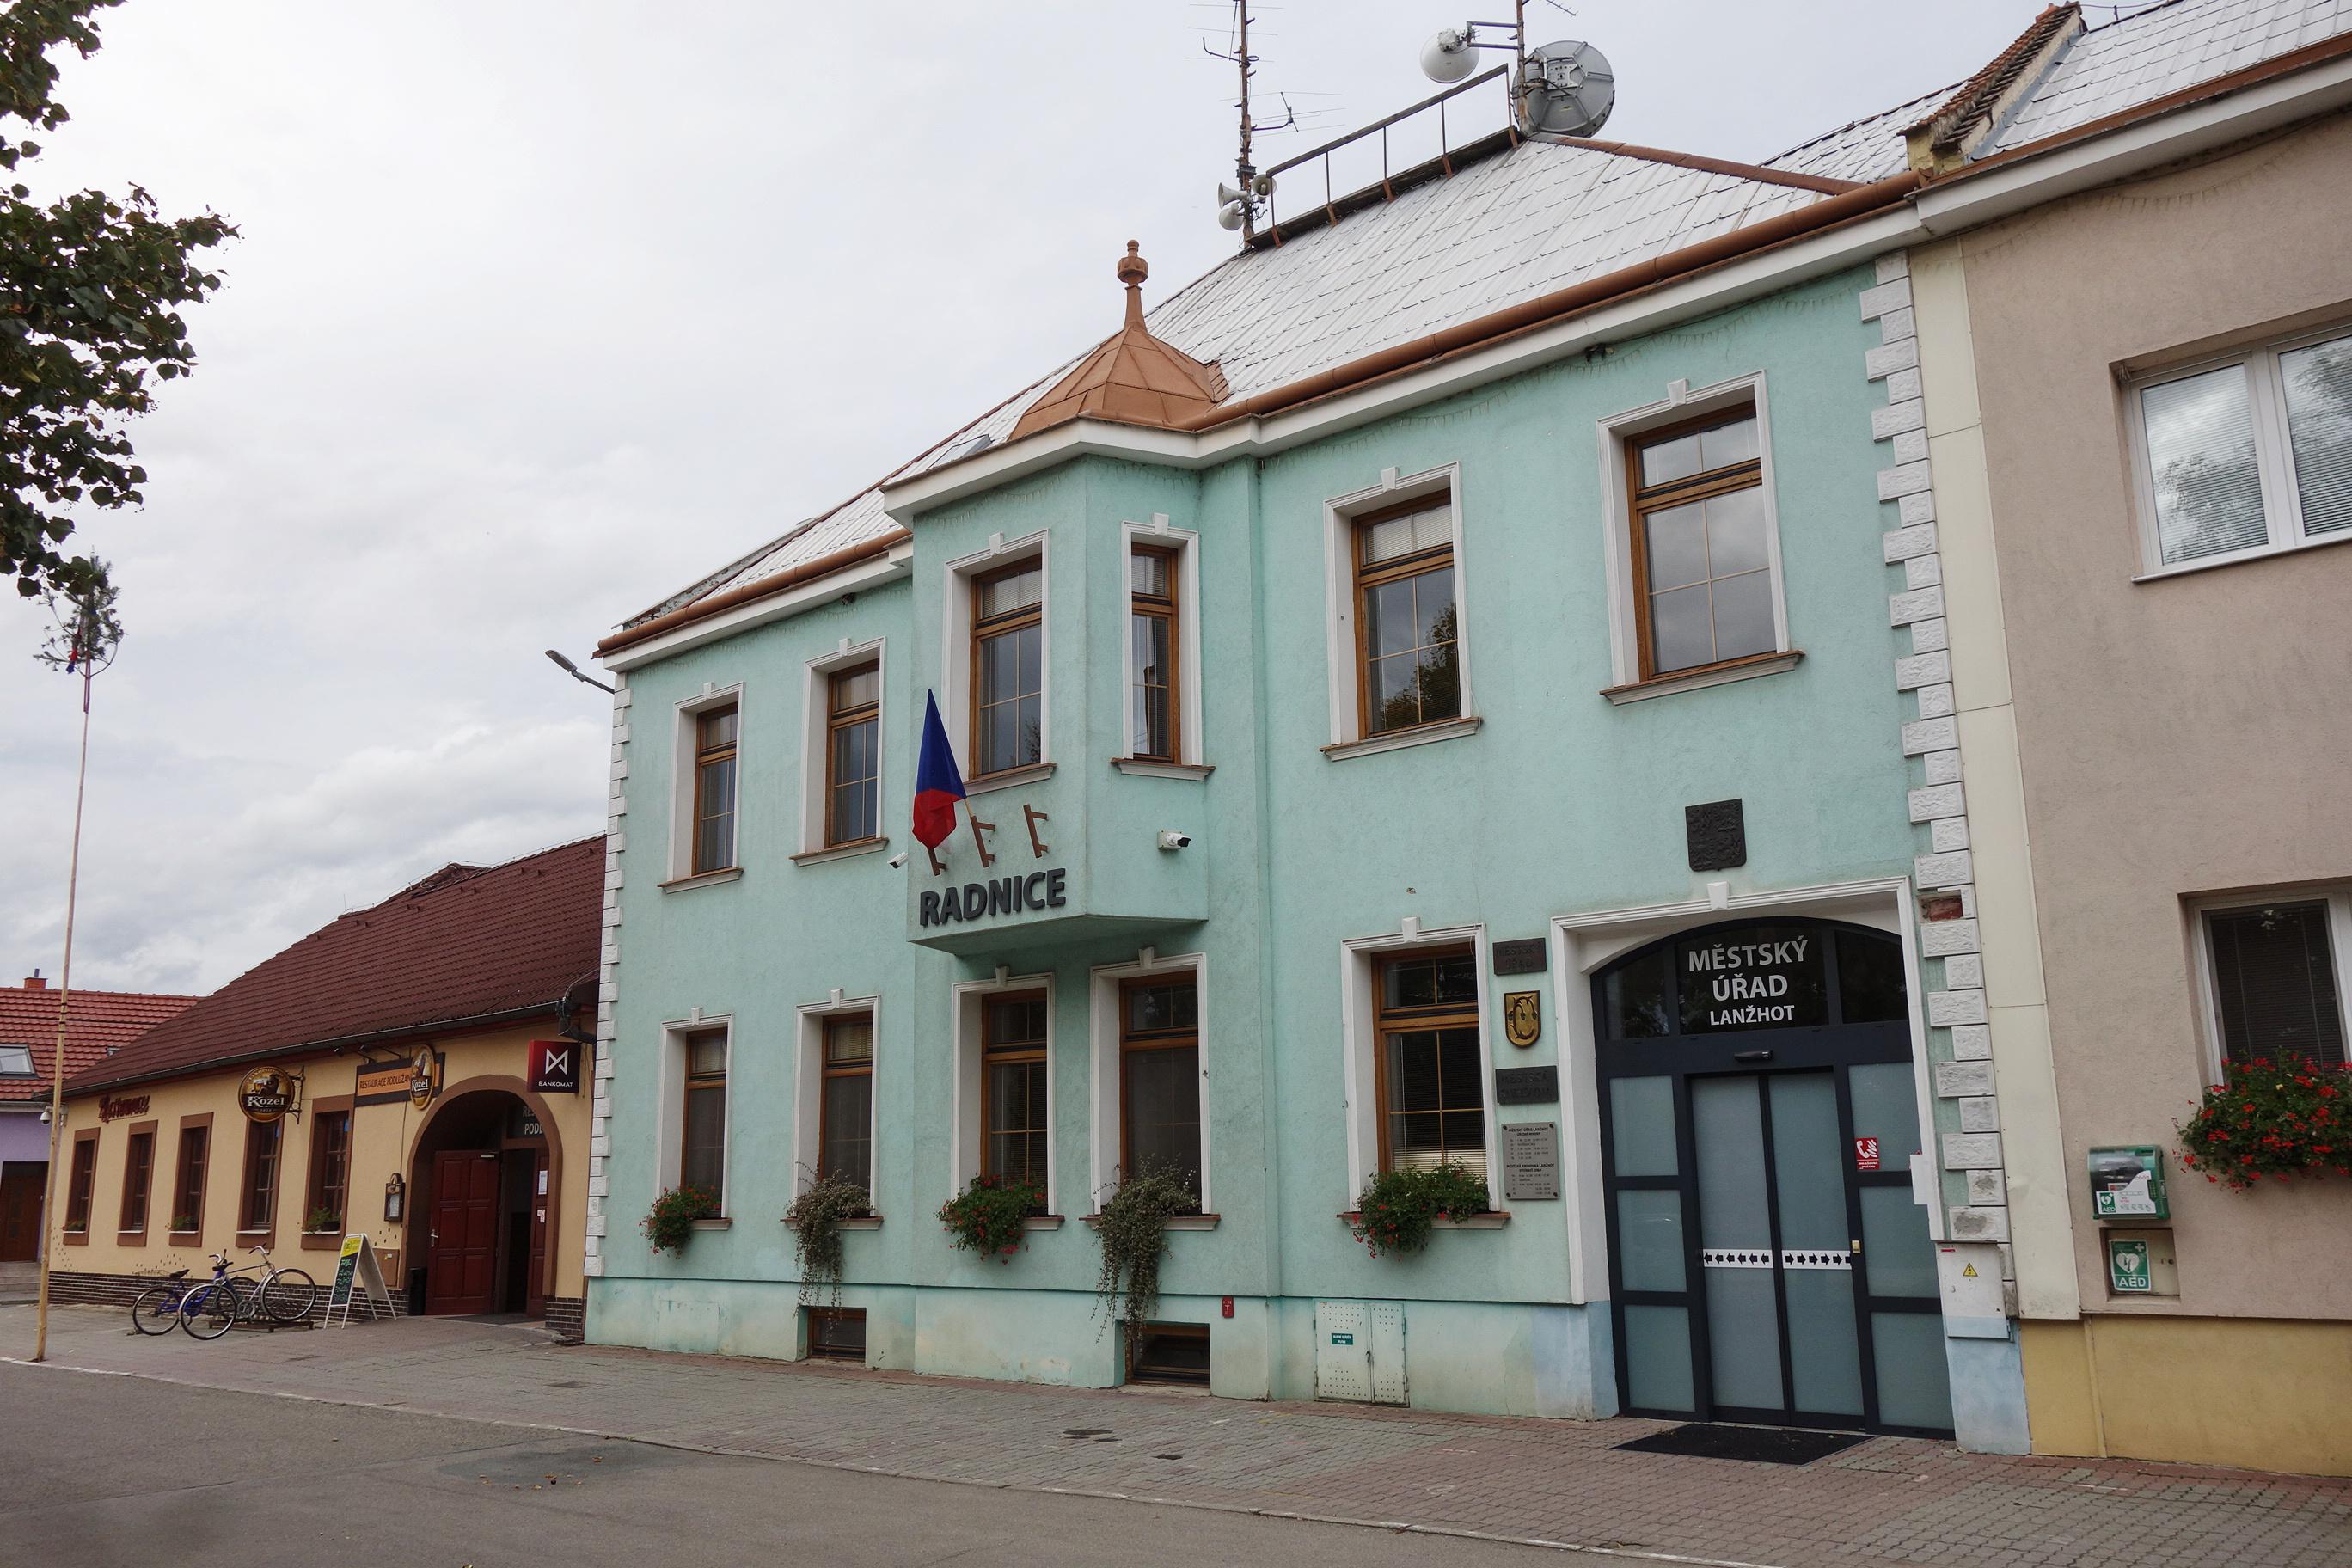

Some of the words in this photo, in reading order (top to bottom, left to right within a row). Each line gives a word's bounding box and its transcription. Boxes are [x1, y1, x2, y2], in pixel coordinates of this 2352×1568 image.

[920, 868, 1066, 927] RADNICE
[1688, 935, 1808, 971] MĚSTSKÝ
[1712, 973, 1788, 1001] ÚŘAD
[1710, 1005, 1795, 1026] LANŽHOT
[359, 1077, 387, 1089] RESTAURACE
[248, 1096, 285, 1107] Kozel
[524, 1123, 542, 1135] PODL
[2119, 1277, 2146, 1287] AED
